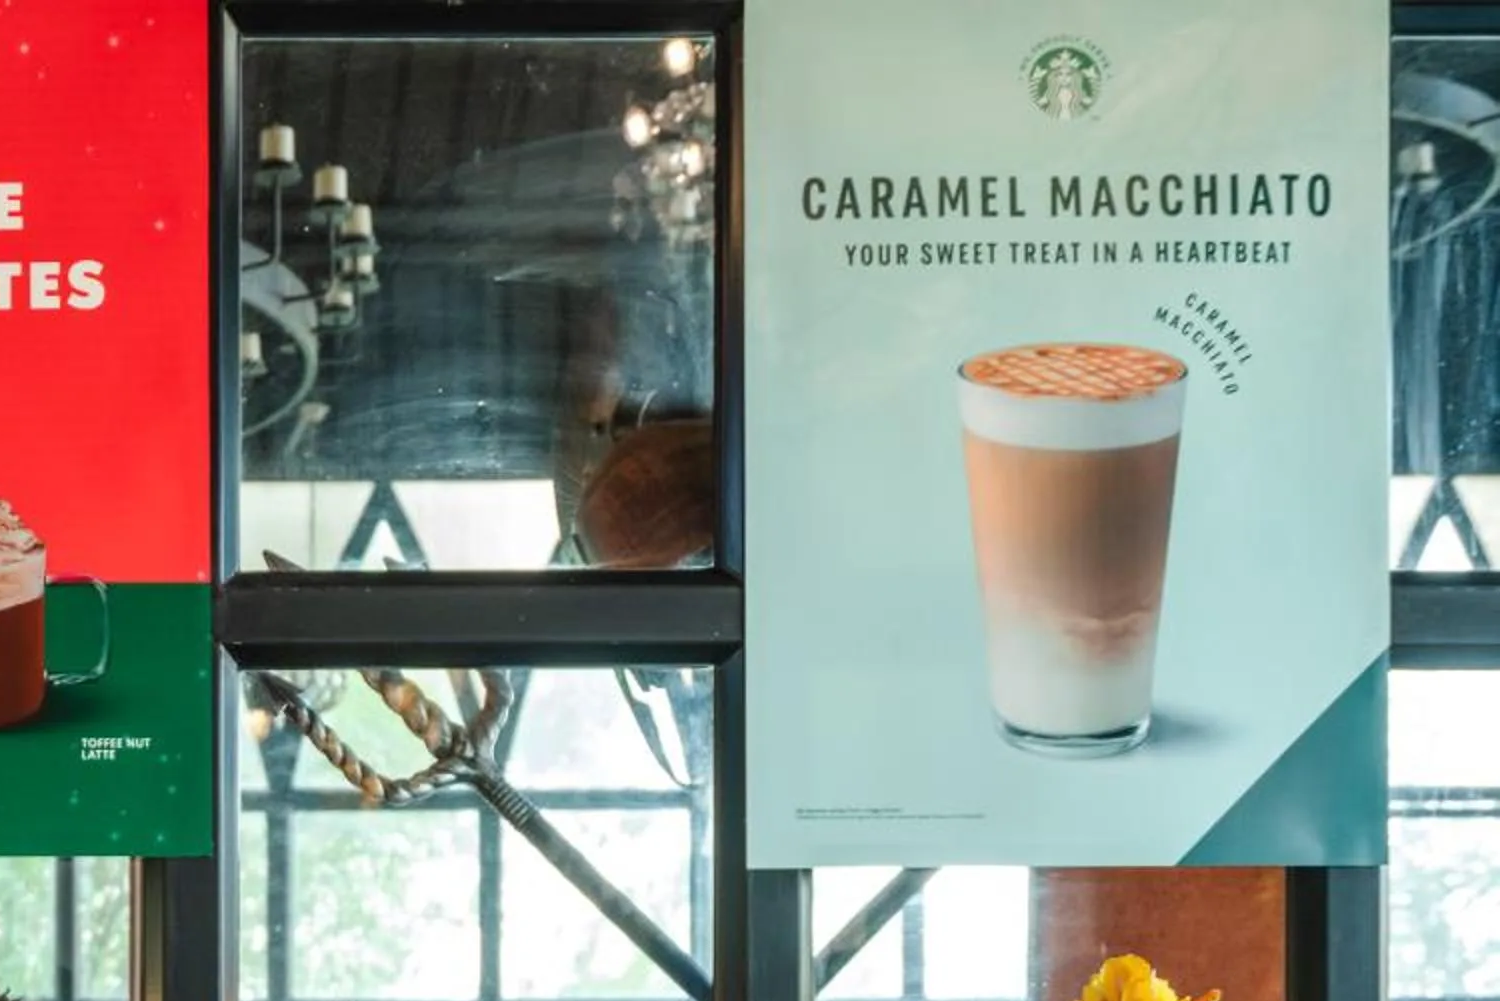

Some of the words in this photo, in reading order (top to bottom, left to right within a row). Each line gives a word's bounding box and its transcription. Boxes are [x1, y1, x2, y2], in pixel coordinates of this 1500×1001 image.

[802, 176, 1026, 220] CARAMEL
[1050, 173, 1332, 218] MACCHIATO
[845, 243, 908, 267] YOUR
[921, 242, 997, 265] SWEET
[1011, 242, 1081, 264] TREAT
[1093, 242, 1117, 263] IN
[1130, 242, 1143, 262] A
[1155, 240, 1291, 263] HEARTBEAT
[1185, 292, 1252, 364] CARAMEL
[1155, 306, 1239, 395] MACCHIATO
[81, 737, 122, 749] TOFFEE
[125, 737, 151, 749] NUT
[81, 749, 115, 760] LATTE
